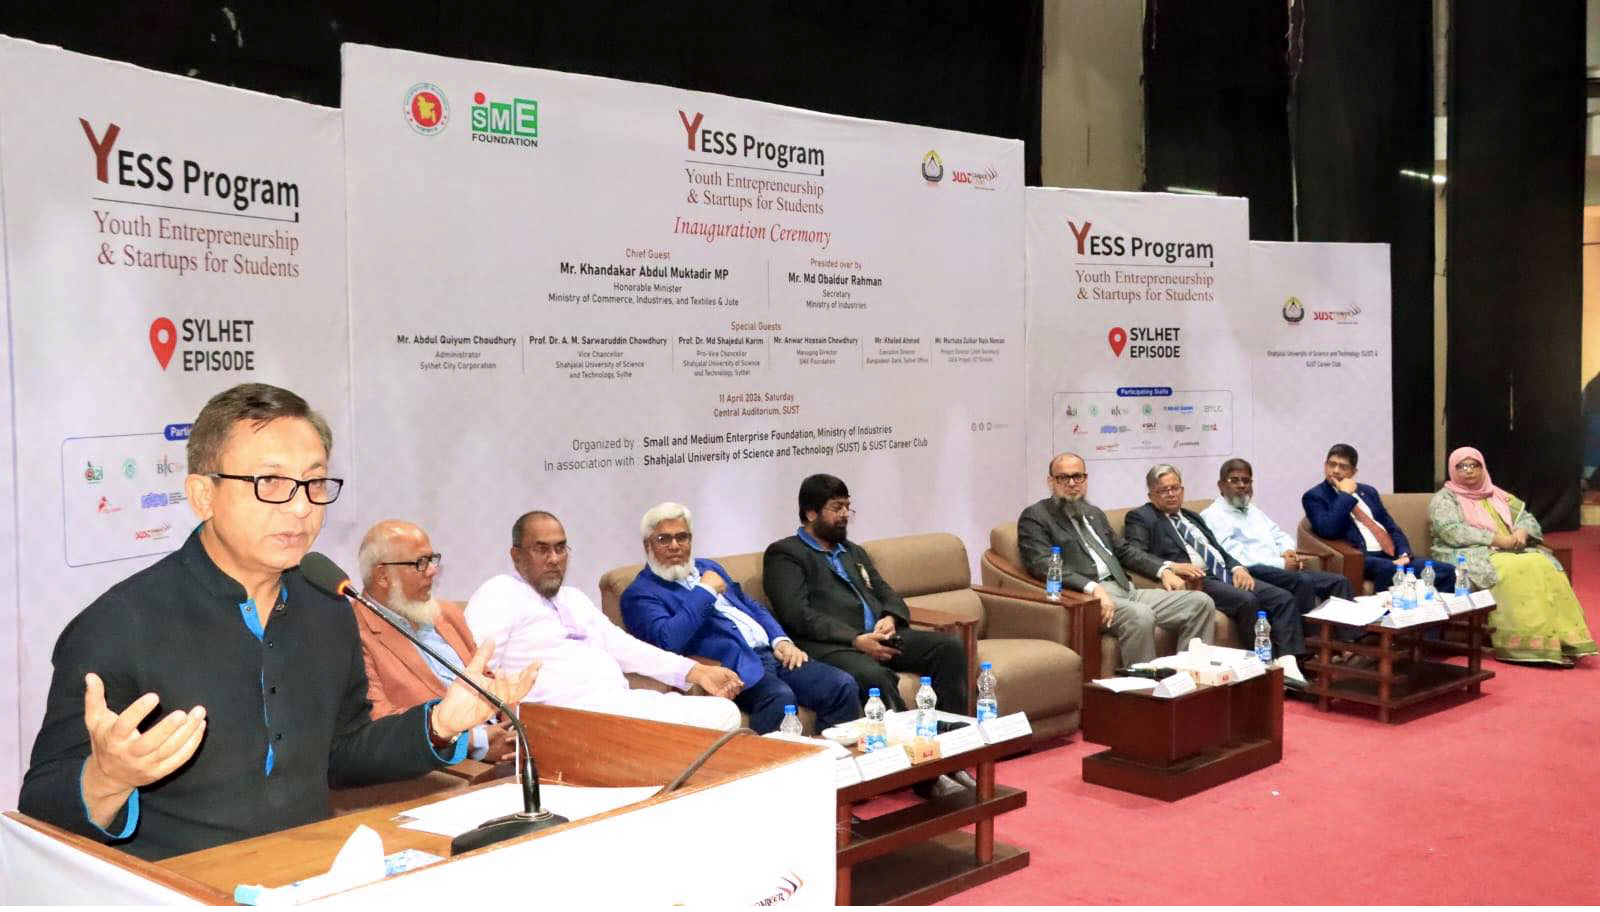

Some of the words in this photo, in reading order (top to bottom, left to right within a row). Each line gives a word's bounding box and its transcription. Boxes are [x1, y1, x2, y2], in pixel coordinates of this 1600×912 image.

[472, 134, 538, 148] FOUNDATION
[679, 110, 737, 155] YESS
[744, 135, 824, 168] Program
[79, 117, 174, 192] YESS
[184, 161, 300, 210] Program
[686, 169, 722, 186] Youth
[727, 172, 824, 199] Entrepreneurship
[687, 189, 698, 204] &
[704, 190, 752, 211] Startups
[757, 194, 773, 210] for
[777, 197, 824, 214] Students
[93, 210, 152, 238] Youth
[159, 217, 298, 255] Entrepreneurship
[674, 216, 766, 242] Inauguration
[770, 224, 832, 249] Ceremony
[1068, 221, 1125, 256] YESS
[1132, 238, 1213, 263] Program
[98, 243, 115, 265] &
[124, 245, 198, 275] Startups
[205, 251, 228, 273] for
[234, 254, 299, 278] Students
[626, 248, 646, 258] Chief
[648, 250, 670, 260] Guest
[810, 258, 838, 268] Presided
[854, 260, 862, 270] by
[560, 262, 577, 274] Mr.
[580, 263, 636, 277] Khandakar
[640, 266, 668, 278] Abdul
[671, 267, 712, 279] Muktadir
[714, 269, 728, 280] MP
[788, 272, 801, 283] Mr.
[804, 274, 816, 284] Md
[818, 274, 848, 284] Obaidur
[851, 275, 882, 286] Rahman
[1076, 270, 1110, 283] Youth
[1116, 271, 1214, 288] Entrepreneurship
[614, 282, 651, 292] Honorable
[654, 284, 682, 292] Minister
[549, 294, 580, 304] Ministry
[582, 294, 590, 302] of
[592, 294, 634, 304] Commerce,
[636, 296, 674, 305] Industries,
[690, 296, 716, 306] Textiles
[718, 297, 723, 306] &
[725, 297, 738, 306] Jute
[823, 290, 850, 299] Secretary
[1077, 287, 1088, 300] &
[1093, 287, 1141, 303] Startups
[1146, 288, 1162, 300] for
[1166, 289, 1214, 302] Students
[806, 300, 830, 310] Ministry
[831, 300, 837, 308] of
[838, 301, 866, 309] Industries
[182, 319, 254, 342] SYLHET
[731, 322, 756, 332] Special
[758, 322, 781, 331] Guests
[397, 336, 410, 344] Mr.
[414, 336, 437, 344] Abdul
[440, 336, 470, 346] Quiyum
[474, 336, 516, 346] Choudhury
[530, 336, 546, 344] Prof.
[549, 336, 560, 344] Dr.
[562, 336, 568, 344] A.
[572, 336, 580, 344] M.
[582, 336, 627, 344] Sarwaruddin
[629, 336, 666, 346] Chowdhury
[1130, 328, 1180, 341] SYLHET
[717, 337, 744, 346] Shajedul
[828, 337, 858, 346] Chowdhury
[1130, 346, 1180, 358] EPISODE
[183, 351, 255, 371] EPISODE
[420, 362, 441, 370] Sylhet
[443, 362, 456, 370] City
[458, 362, 496, 370] Corporation
[556, 361, 583, 369] Shahjalal
[720, 394, 725, 402] 11
[727, 394, 744, 403] April
[765, 393, 794, 402] Saturday
[714, 408, 740, 417] Central
[742, 408, 780, 416] Auditorium,
[783, 406, 800, 415] SUST
[572, 438, 621, 452] Organized
[624, 438, 634, 450] by
[644, 436, 670, 448] Small
[672, 435, 688, 446] and
[690, 434, 724, 446] Medium
[726, 430, 768, 444] Enterprise
[771, 429, 816, 440] Foundation,
[818, 426, 846, 438] Ministry
[848, 426, 856, 436] of
[858, 426, 892, 436] Industries
[544, 460, 554, 472] In
[556, 457, 612, 470] association
[615, 457, 634, 467] with
[644, 453, 685, 466] Shahjalal
[688, 451, 730, 464] University
[732, 450, 740, 460] of
[743, 448, 774, 459] Science
[776, 446, 790, 456] and
[793, 445, 834, 456] Technology
[836, 442, 860, 454] (SUST)
[862, 442, 868, 451] &
[870, 441, 888, 450] SUST
[889, 439, 912, 449] Career
[914, 438, 928, 447] Club
